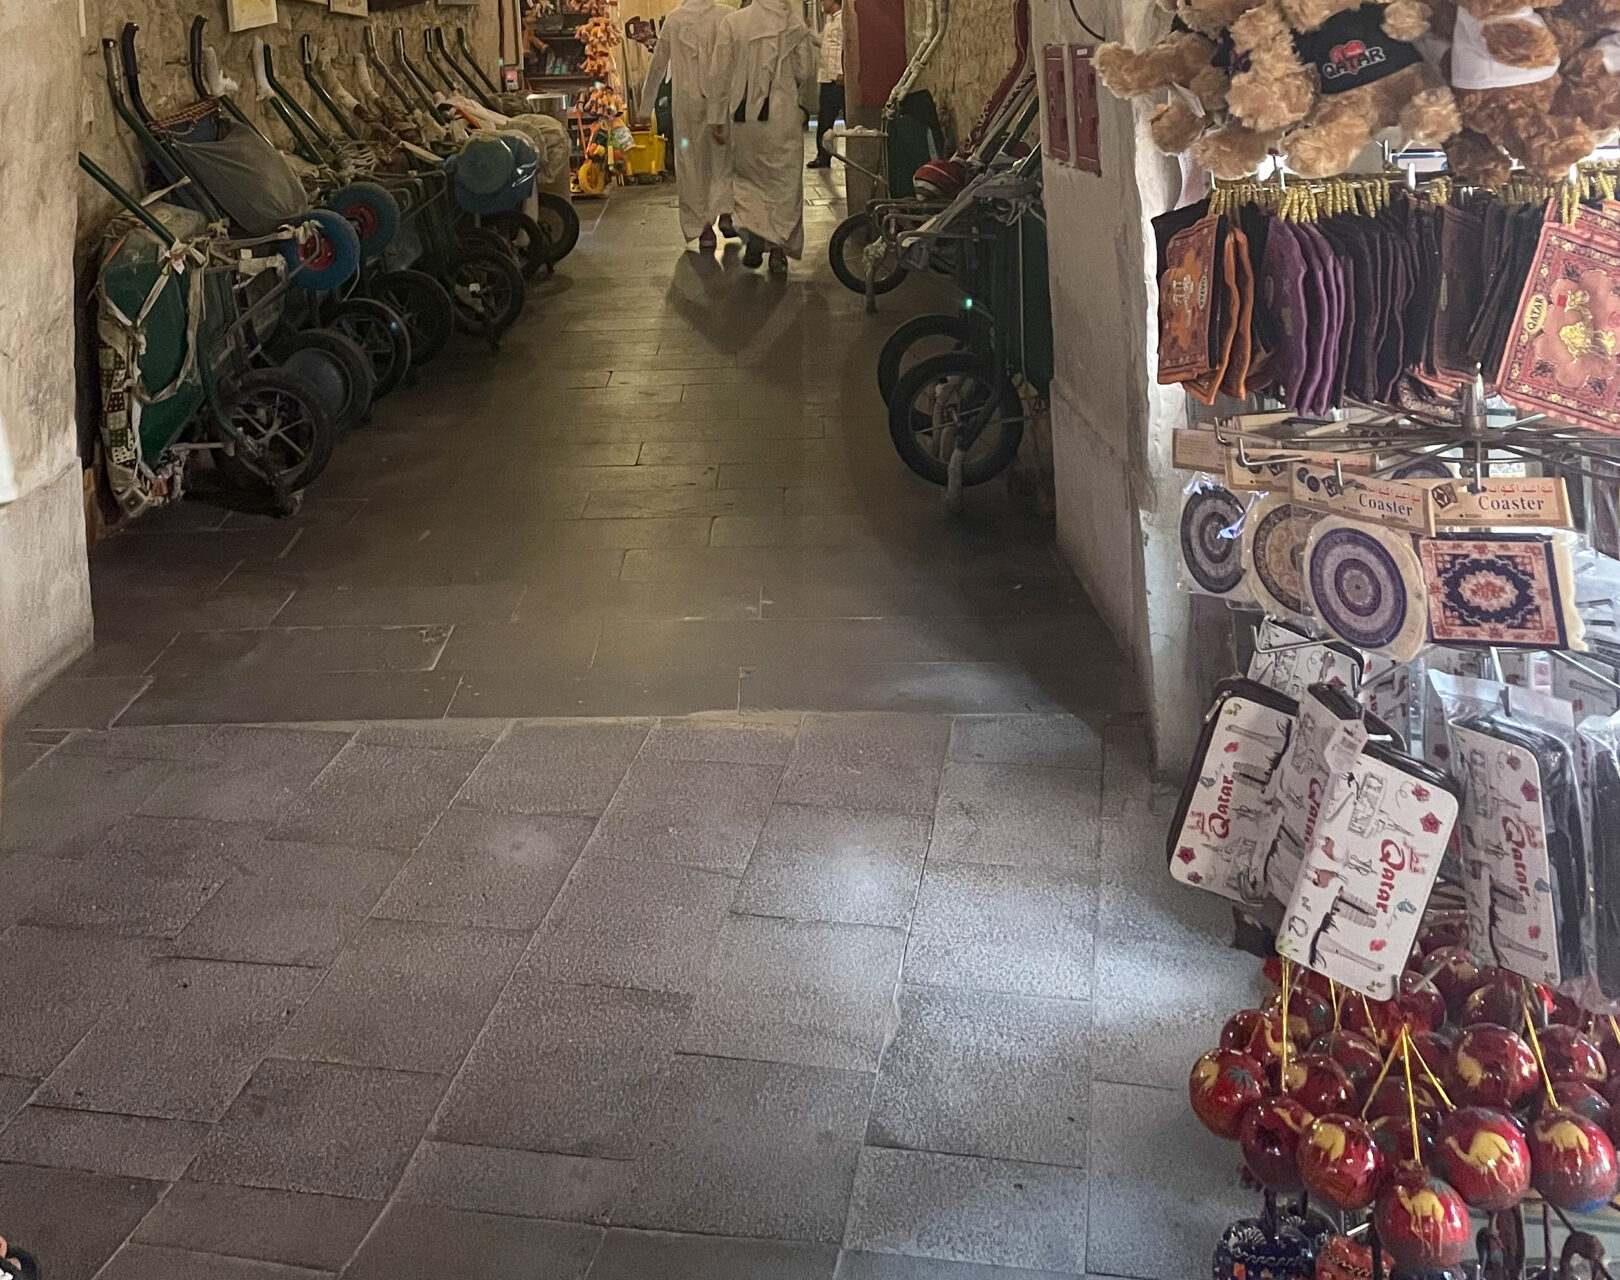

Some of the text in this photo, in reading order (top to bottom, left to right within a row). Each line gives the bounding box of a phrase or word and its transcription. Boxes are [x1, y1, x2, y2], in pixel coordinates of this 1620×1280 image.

[1322, 46, 1386, 79] QATAR
[1526, 296, 1545, 330] QATAR
[1358, 493, 1413, 517] Coaster
[1478, 495, 1545, 511] Coaster
[1208, 775, 1234, 839] Qatar
[1502, 816, 1531, 897] Qatar
[1375, 838, 1406, 914] Qatar
